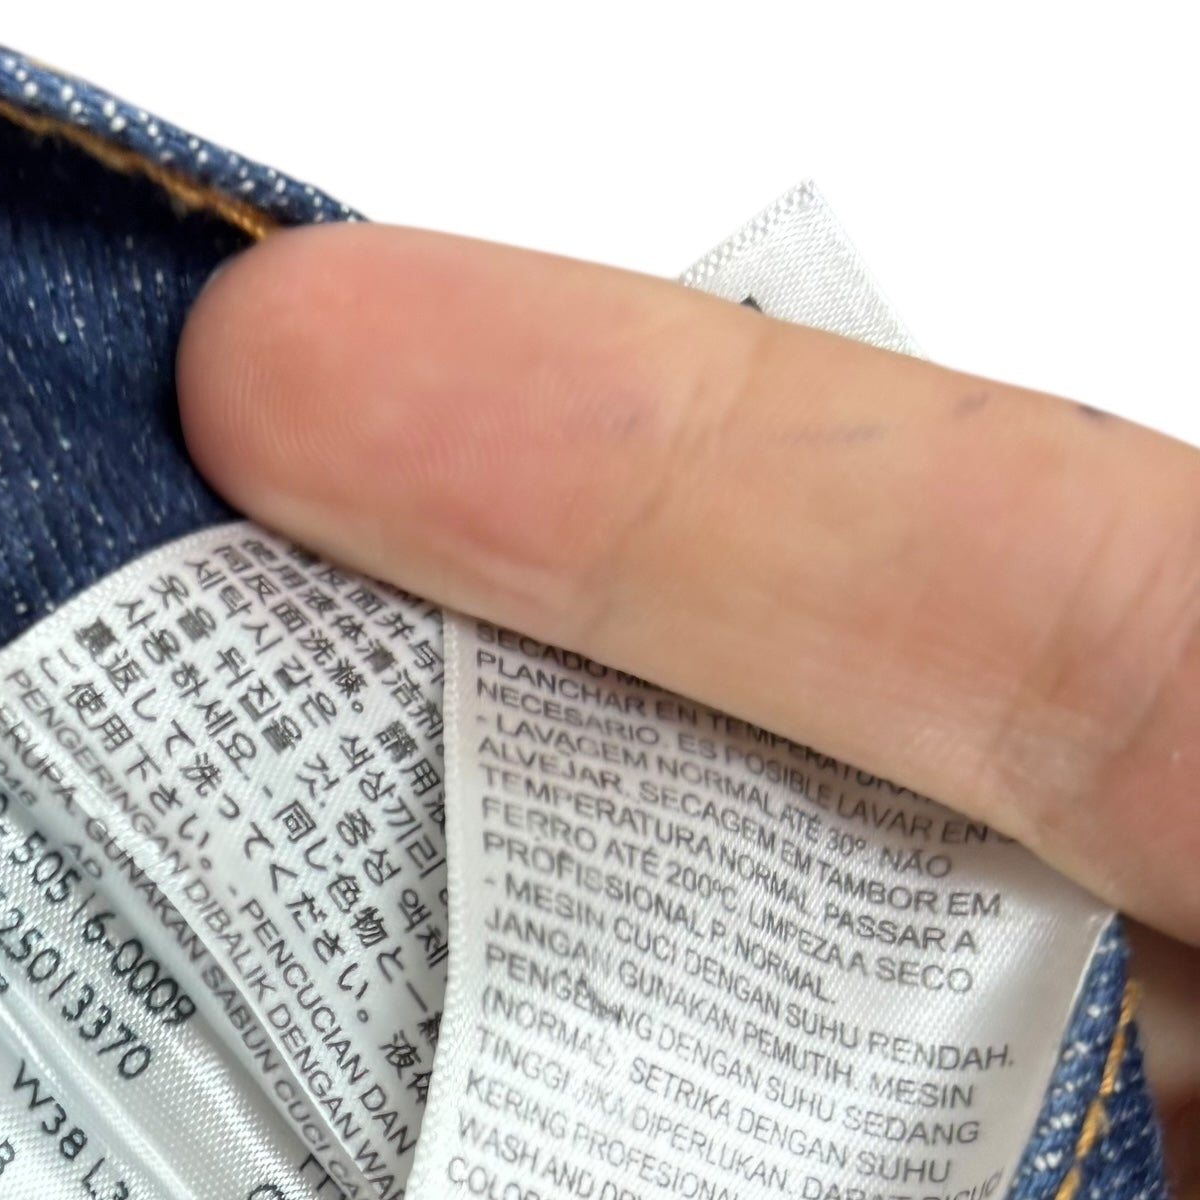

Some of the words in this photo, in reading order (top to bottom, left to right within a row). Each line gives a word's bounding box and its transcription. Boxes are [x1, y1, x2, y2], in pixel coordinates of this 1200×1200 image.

[115, 600, 256, 780] 사용하세요.
[149, 575, 216, 642] 옷을
[336, 808, 402, 886] 중성
[184, 560, 283, 655] 세탁시
[274, 655, 337, 728] 같은
[339, 736, 446, 879] 색상끼리
[476, 648, 646, 717] PLANCHAR
[656, 701, 698, 726] EN
[480, 763, 714, 863] TEMPERATURA
[824, 903, 945, 951] PASSAR
[953, 930, 978, 955] A
[497, 713, 648, 769] LAVAGEM
[657, 755, 778, 820] NORMAL
[780, 803, 821, 842] ATÉ
[880, 846, 952, 878] NÃO
[638, 780, 776, 850] SECAGEM
[781, 839, 811, 875] EM
[817, 859, 938, 913] TAMBOR
[947, 892, 1001, 918] EM
[678, 731, 718, 760] ES
[725, 744, 835, 809] POSIBLE
[838, 793, 933, 840] LAVAR
[942, 823, 989, 844] EN
[5, 668, 189, 875] PENGERINGAN
[184, 878, 276, 1002] DIBALIK
[268, 1002, 361, 1140] DENGAN
[482, 796, 598, 852] FERRO
[603, 838, 659, 877] ATÉ
[875, 957, 974, 994] SECO
[483, 831, 704, 940] PROFISSIONAL
[735, 935, 836, 1005] NORMAL.
[505, 872, 605, 931] MESIN
[613, 915, 676, 966] CUCI
[684, 947, 780, 1018] DENGAN
[785, 1001, 859, 1050] SUHU
[868, 1031, 1015, 1071] RENDAH.
[85, 817, 207, 962] GUNAKAN
[202, 964, 279, 1073] SABUN
[273, 1079, 330, 1153] CUCI
[238, 899, 369, 1086] PENCUCIAN
[359, 1083, 417, 1155] DAN
[485, 907, 612, 978] JANGAN
[619, 959, 737, 1038] GUNAKAN
[868, 1070, 974, 1109] MESIN
[13, 1058, 88, 1161] W38
[457, 1109, 539, 1174] WASH
[542, 1156, 594, 1199] AND
[466, 1068, 567, 1139] KERING
[477, 1024, 571, 1094] TINGGI
[631, 1105, 794, 1195] DIPERLUKAN.
[629, 1056, 731, 1125] SETRIKA
[736, 1108, 848, 1170] DENGAN
[856, 1150, 952, 1184] SUHU
[658, 1023, 760, 1095] DENGAN
[765, 1075, 834, 1123] SUHU
[842, 1105, 981, 1145] SEDANG
